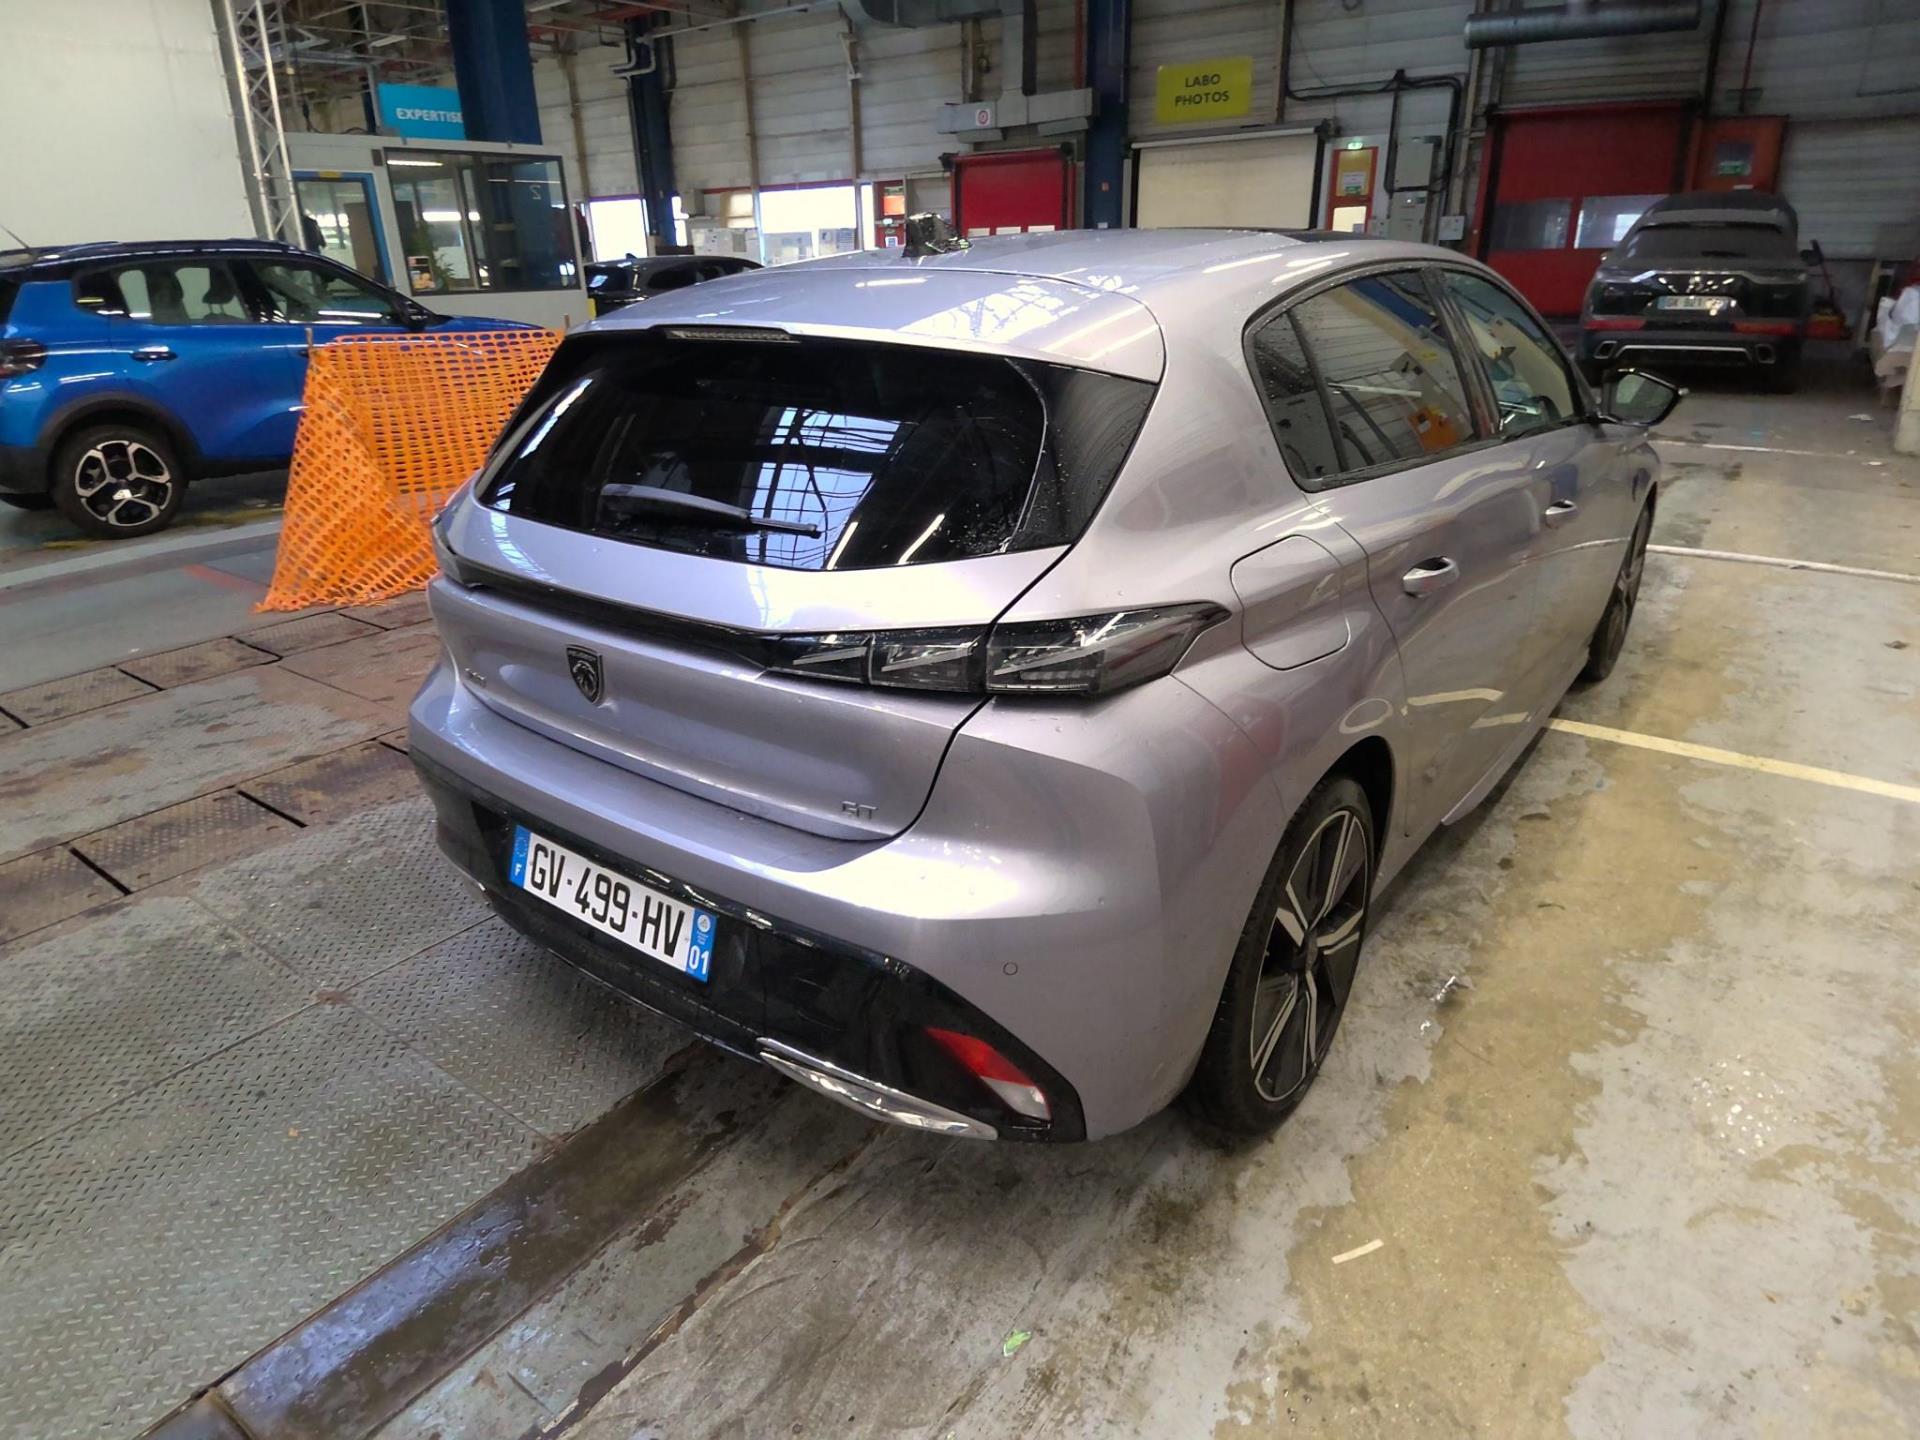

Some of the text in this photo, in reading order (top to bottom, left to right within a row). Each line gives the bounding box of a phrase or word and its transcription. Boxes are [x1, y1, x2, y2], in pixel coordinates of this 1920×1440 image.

[1185, 74, 1221, 88] LABO
[1175, 91, 1230, 107] PHOTOS
[841, 800, 878, 820] GT
[530, 843, 686, 958] GV-499-HV
[688, 945, 710, 975] 01
